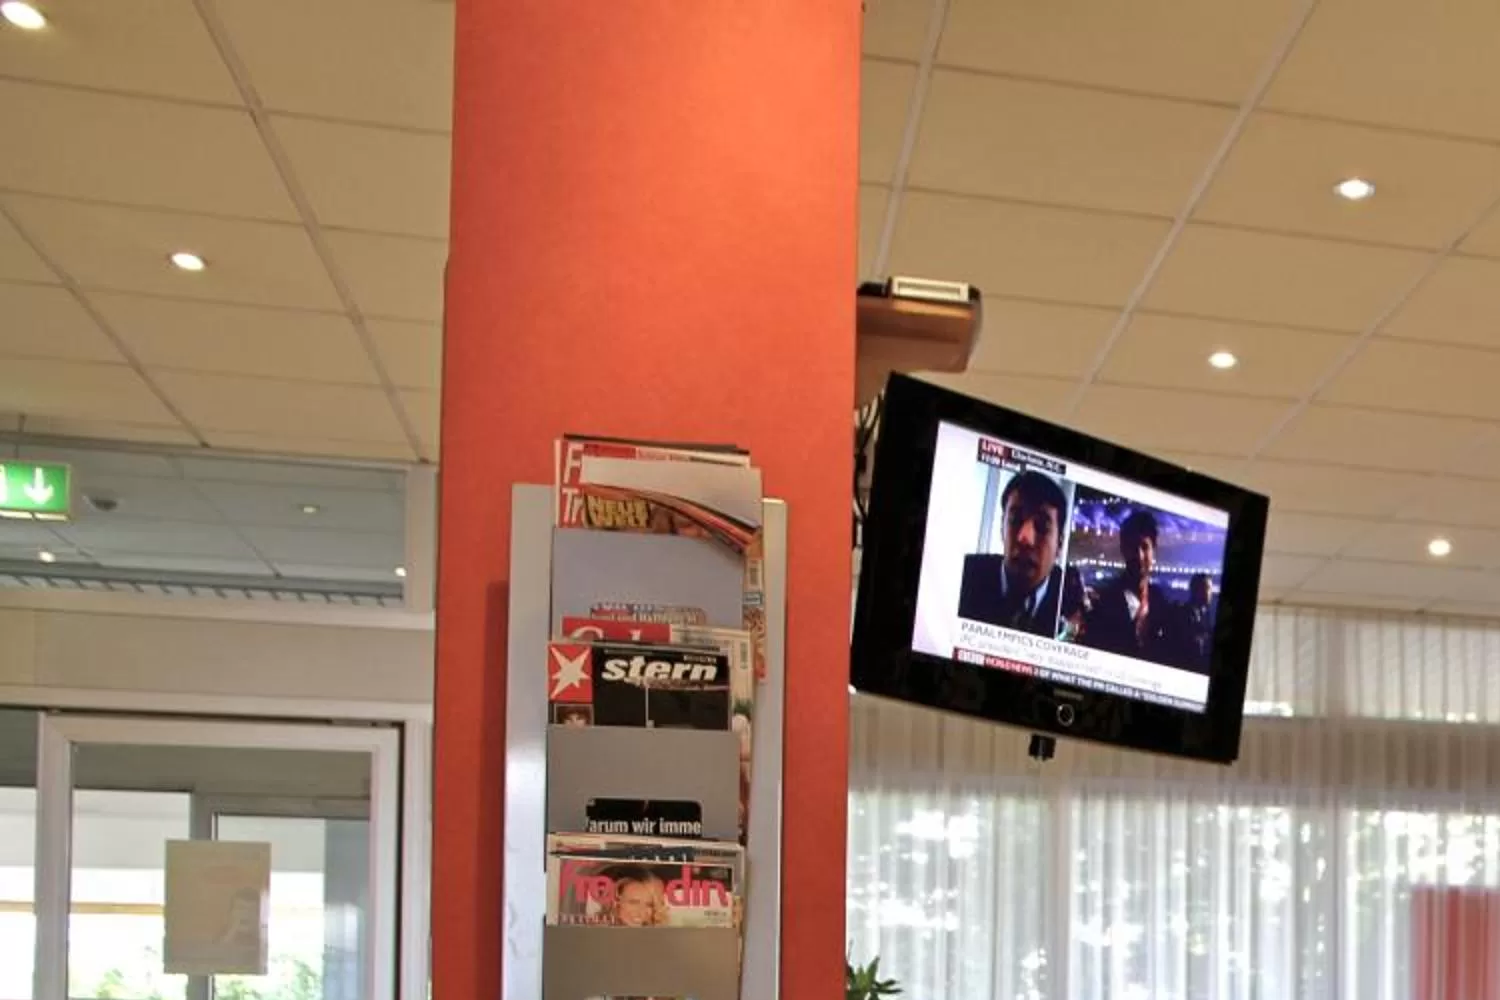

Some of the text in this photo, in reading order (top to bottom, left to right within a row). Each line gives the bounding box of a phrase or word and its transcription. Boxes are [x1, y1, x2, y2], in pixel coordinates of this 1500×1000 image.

[961, 621, 1090, 660] PARALYMPICS COVERAGE
[601, 655, 718, 683] stern
[587, 817, 702, 835] arum wir imme
